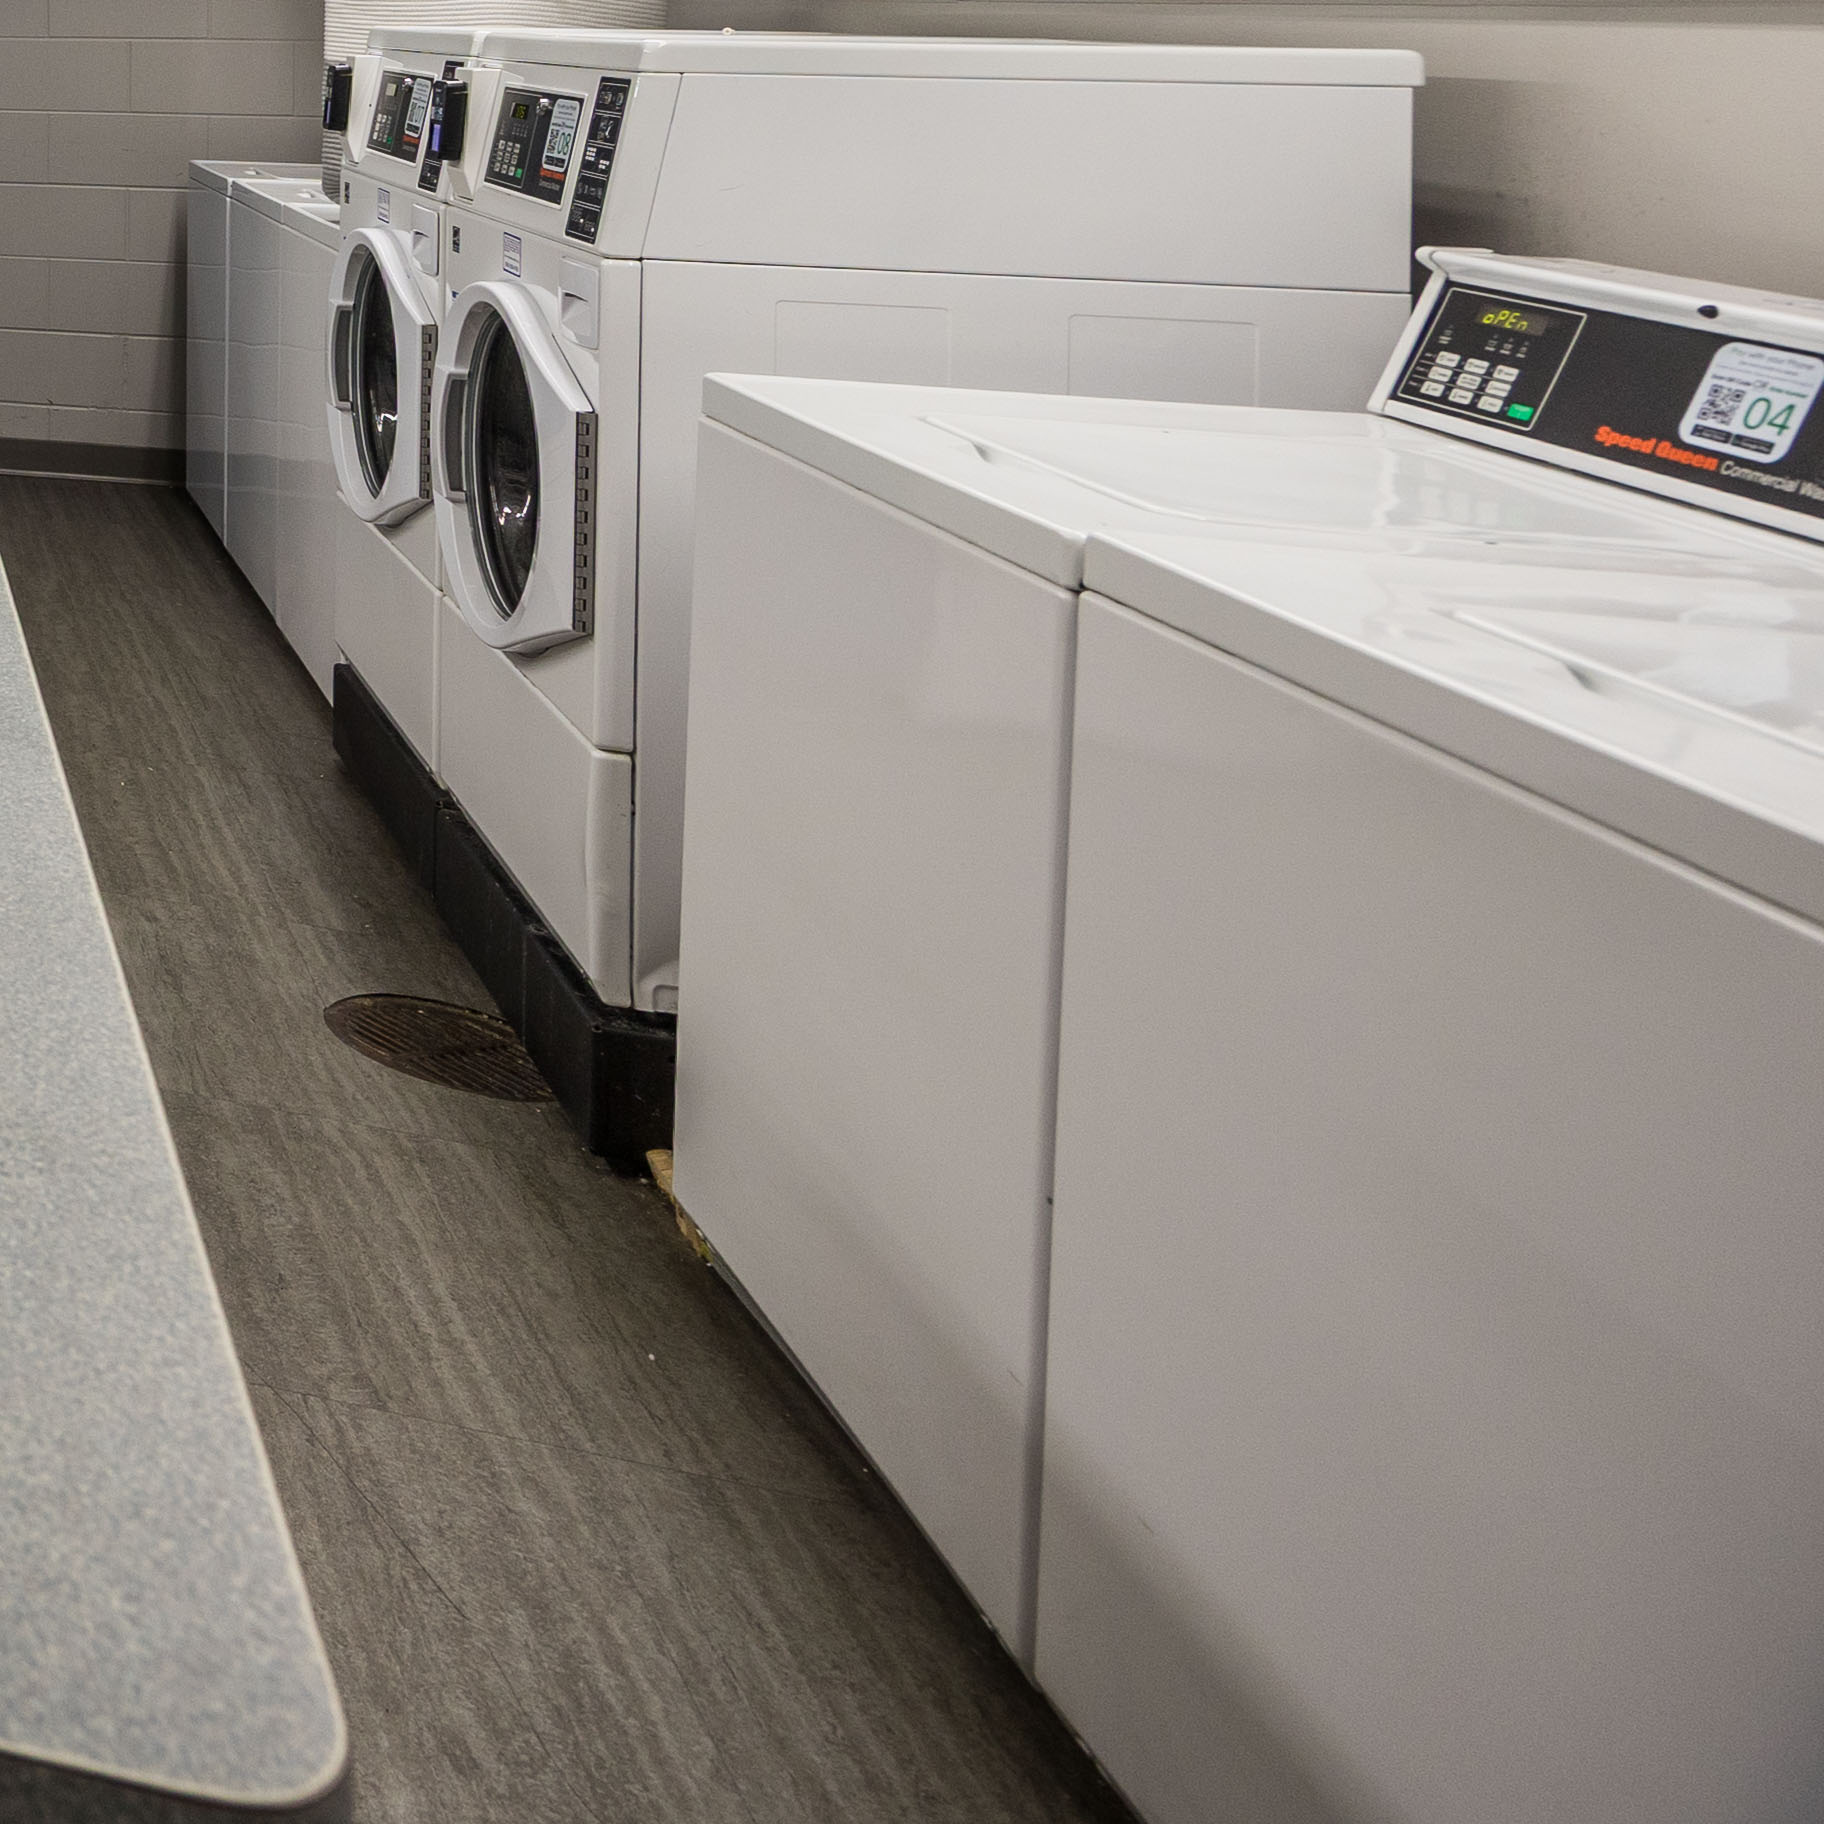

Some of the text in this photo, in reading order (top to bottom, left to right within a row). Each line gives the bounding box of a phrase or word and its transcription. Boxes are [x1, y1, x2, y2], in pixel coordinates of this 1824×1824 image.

[556, 132, 572, 156] 08
[1743, 397, 1796, 436] 04
[1594, 425, 1657, 455] Speed
[1655, 440, 1719, 472] Queen
[1719, 460, 1801, 494] Commercial
